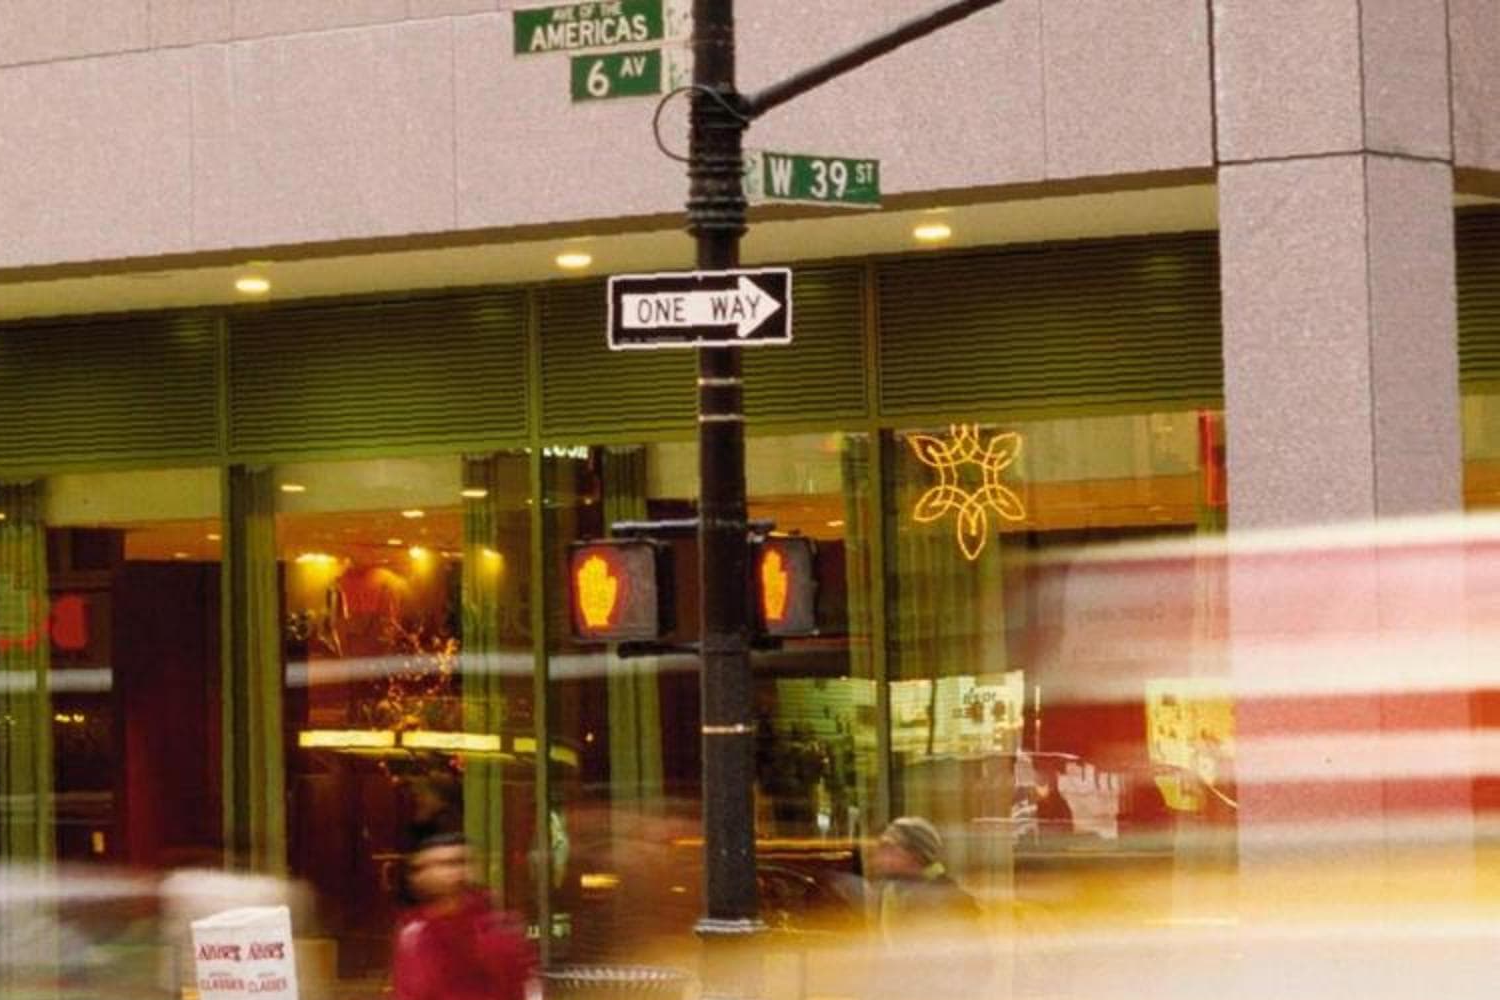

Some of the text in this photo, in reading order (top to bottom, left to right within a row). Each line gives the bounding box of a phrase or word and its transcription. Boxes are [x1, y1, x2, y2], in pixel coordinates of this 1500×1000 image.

[529, 14, 649, 51] AMERICAS
[586, 57, 647, 97] 6 AV
[769, 157, 874, 199] W 39 ST
[637, 295, 761, 324] ONE WAY
